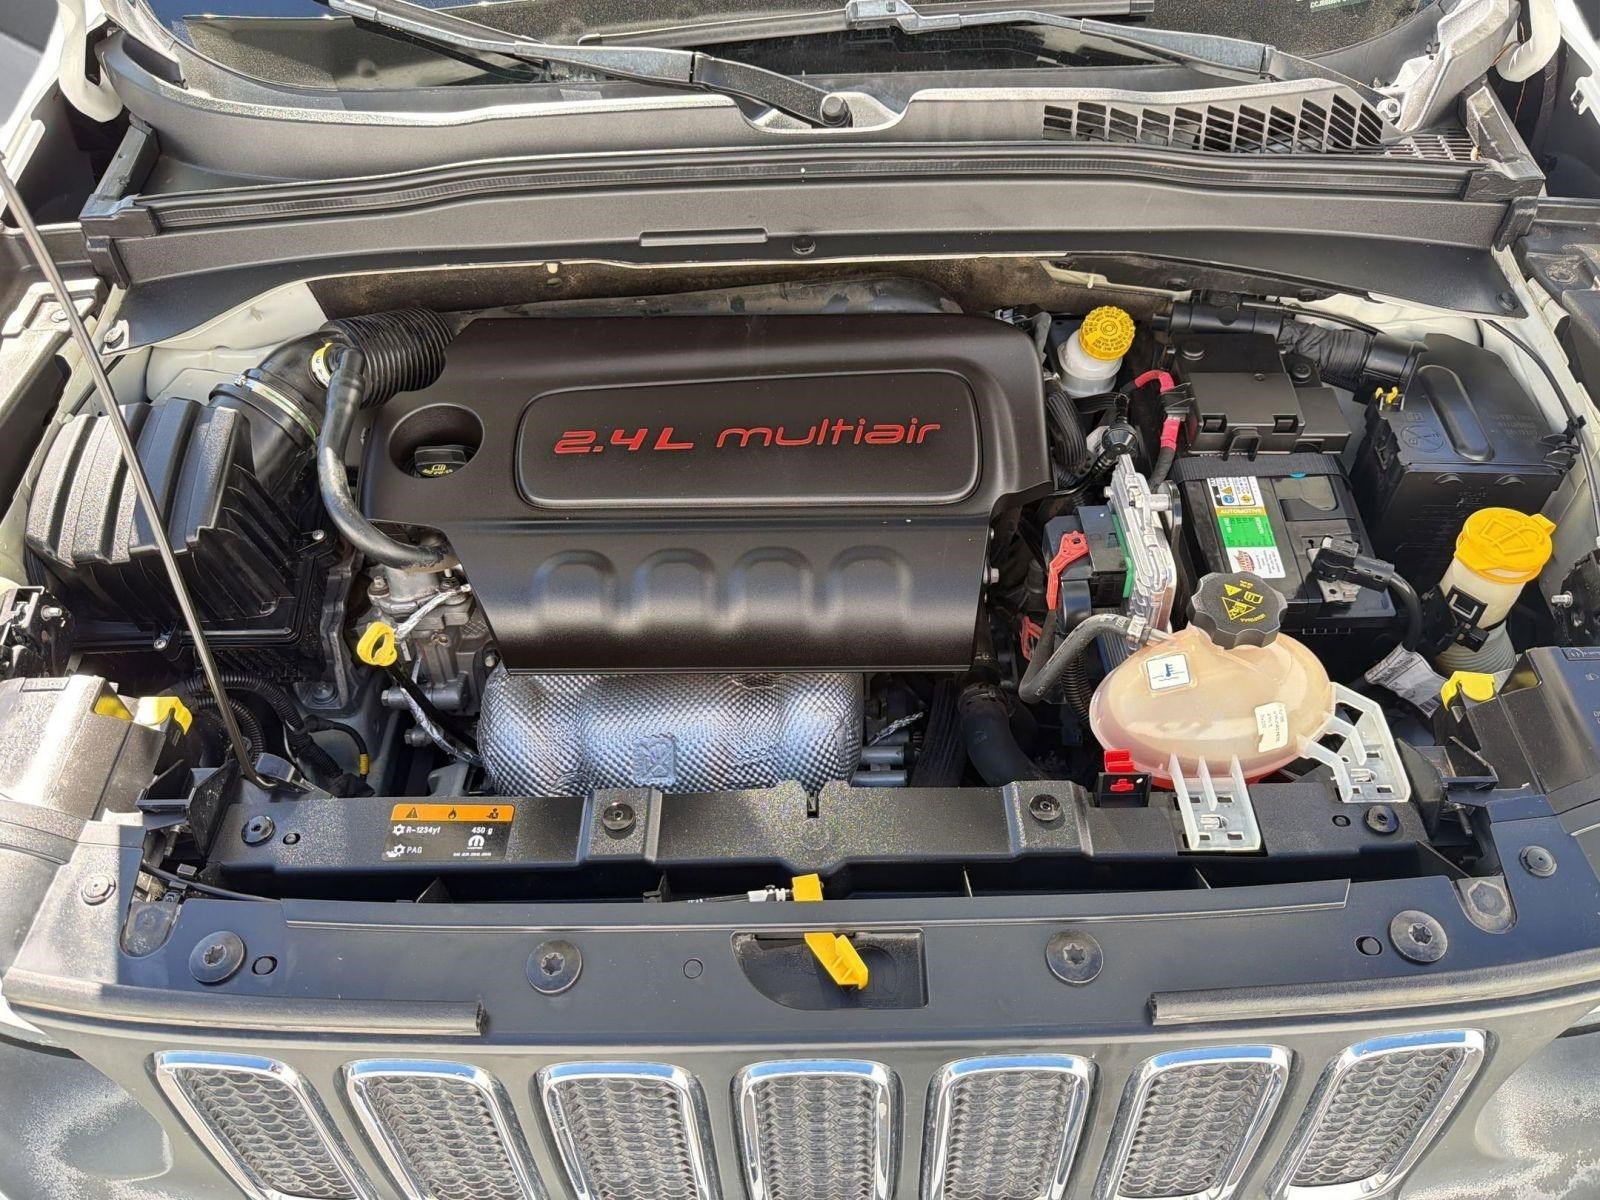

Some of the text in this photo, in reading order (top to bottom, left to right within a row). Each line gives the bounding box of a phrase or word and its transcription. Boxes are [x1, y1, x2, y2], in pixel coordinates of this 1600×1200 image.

[716, 416, 941, 448] multiair
[406, 826, 441, 835] R-1234yf
[471, 826, 486, 835] 450
[406, 846, 423, 854] PAG
